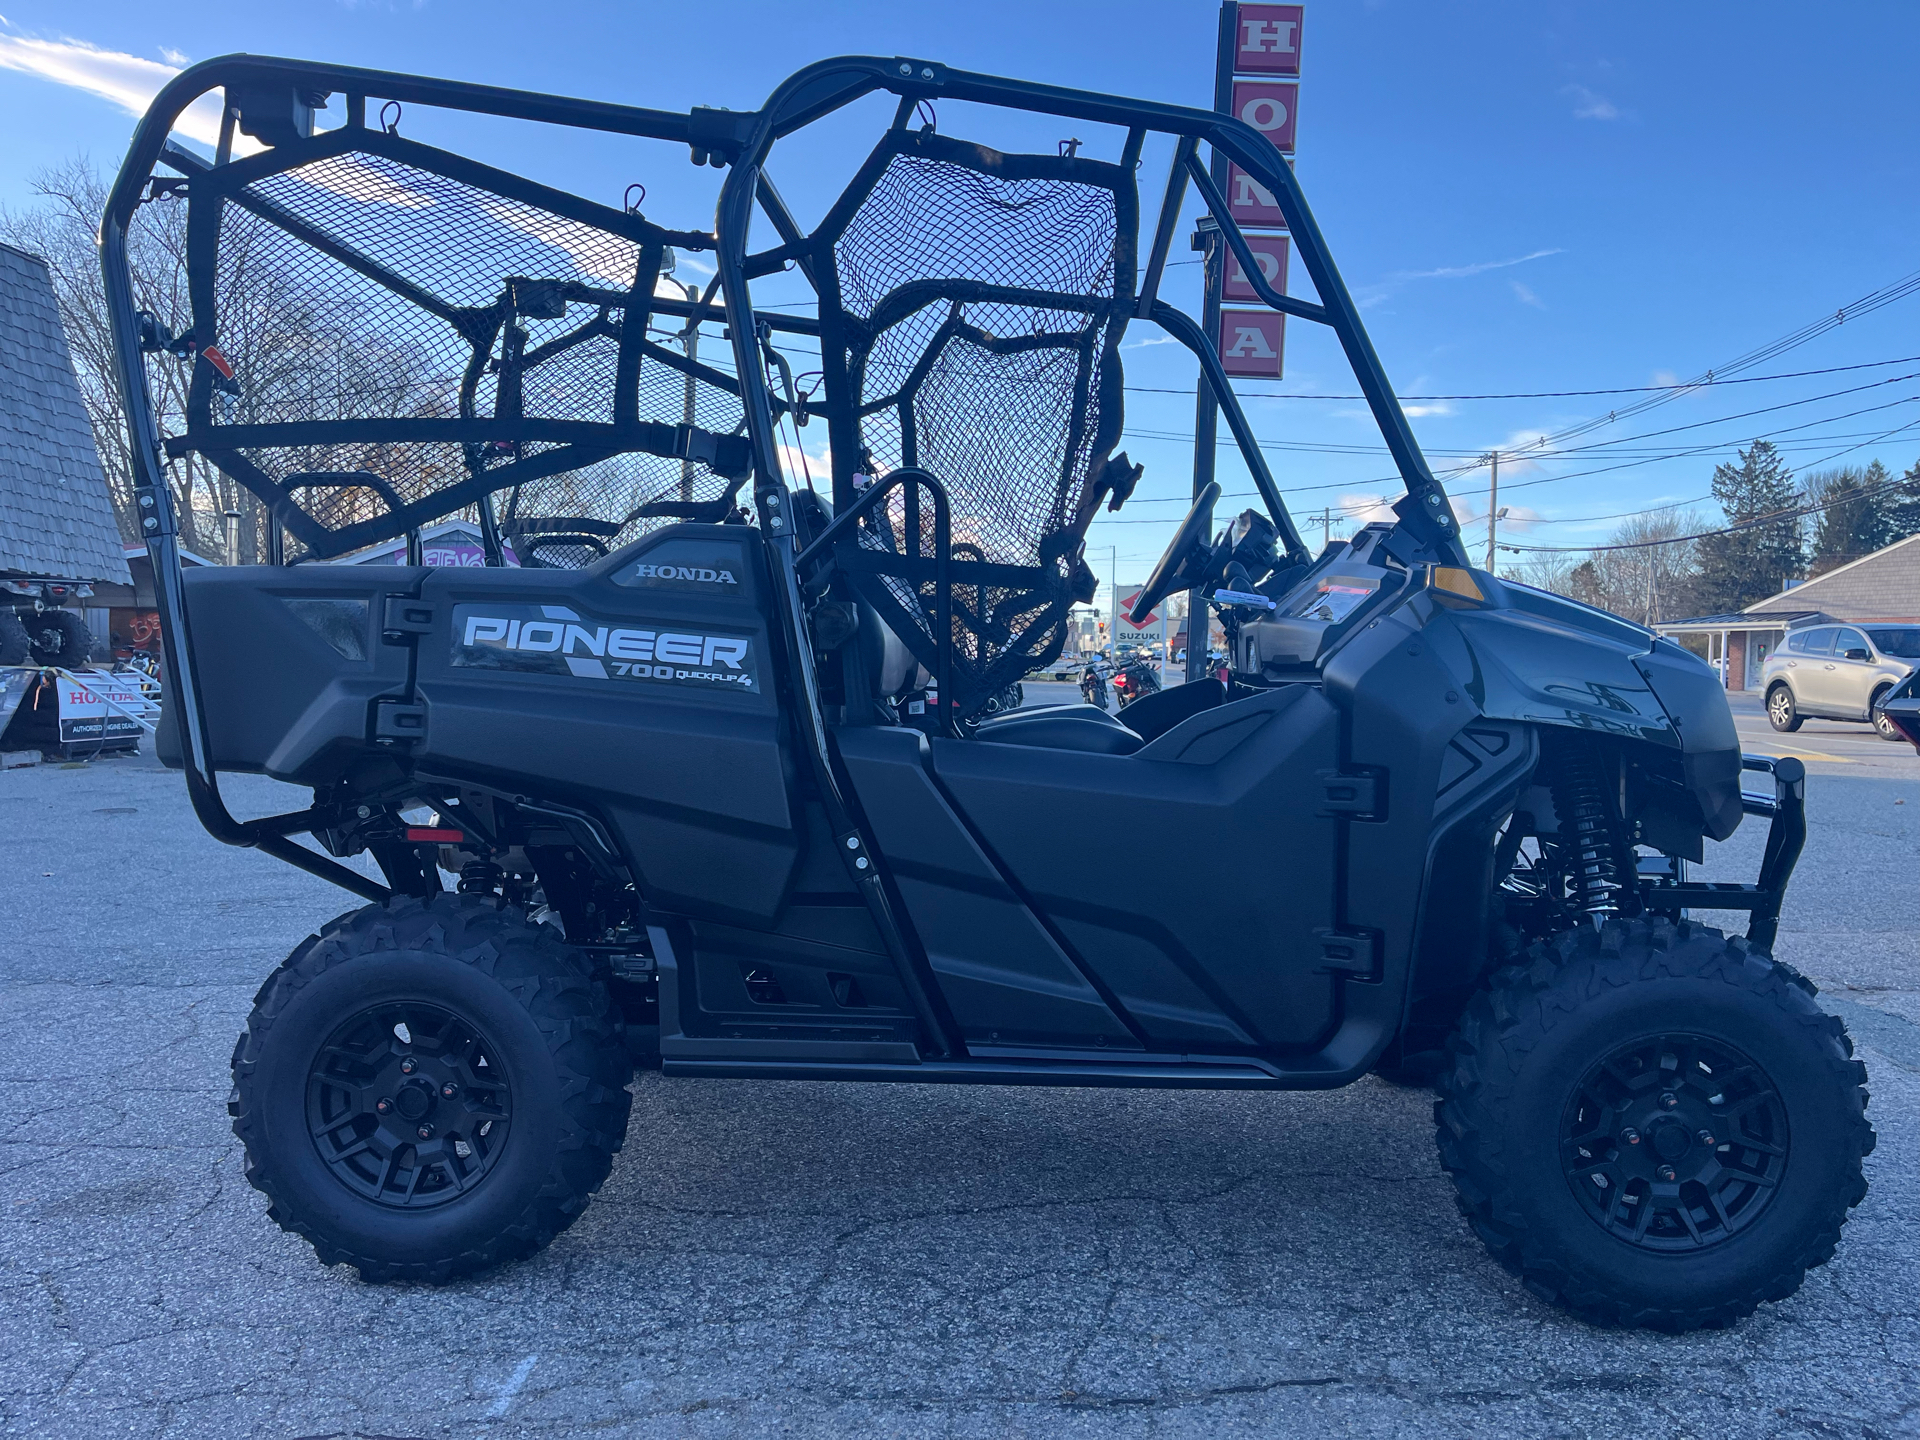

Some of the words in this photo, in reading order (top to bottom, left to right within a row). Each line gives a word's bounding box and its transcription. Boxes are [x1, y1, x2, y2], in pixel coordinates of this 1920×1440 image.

[635, 564, 737, 584] HONDA
[464, 616, 748, 669] PIONEER
[1119, 632, 1160, 641] SUZUKI
[611, 661, 674, 680] 700
[69, 691, 134, 704] HODA
[73, 725, 102, 733] AUTHORIZED
[103, 723, 121, 731] NGINE
[122, 722, 138, 730] DEALER
